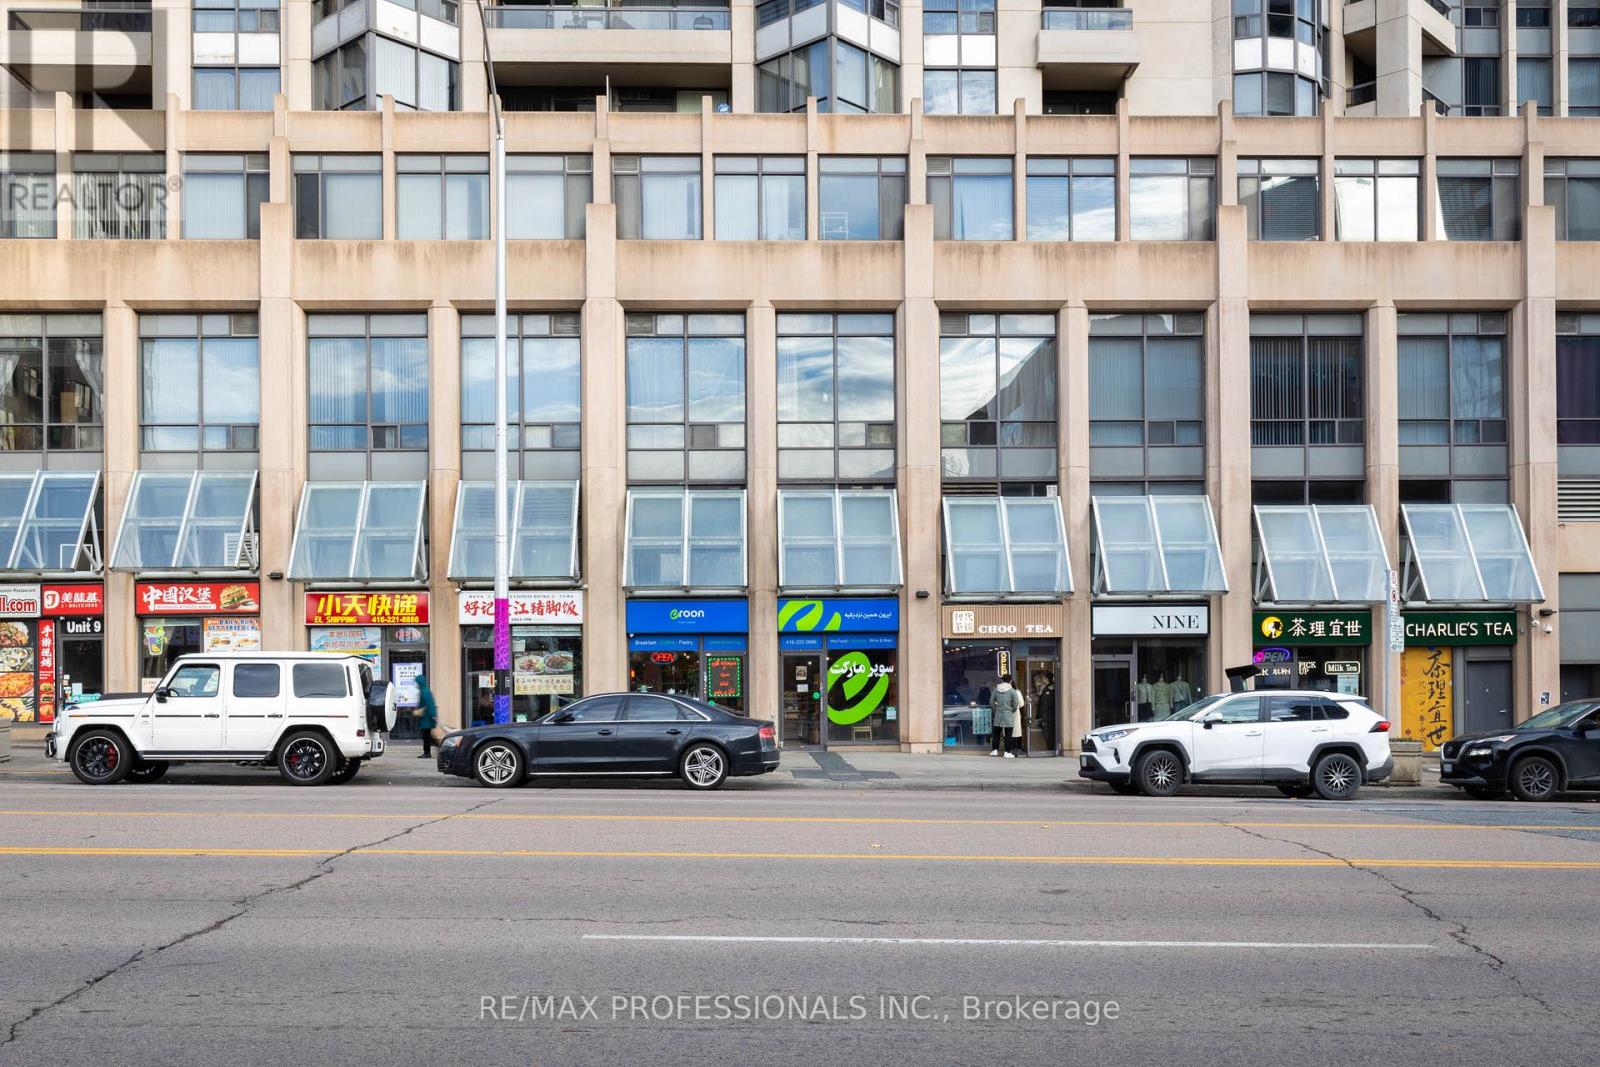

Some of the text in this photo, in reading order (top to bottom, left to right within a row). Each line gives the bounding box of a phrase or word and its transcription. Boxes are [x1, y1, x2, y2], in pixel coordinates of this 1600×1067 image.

[142, 585, 212, 612] 中国汉堡
[318, 594, 418, 616] 小天快递
[464, 600, 579, 617] 好记江猪脚饭
[670, 609, 704, 620] eroon
[66, 621, 101, 633] Unit 9
[979, 624, 1054, 634] CHOO TEA
[1153, 615, 1199, 629] NINE
[1288, 618, 1362, 637] 茶理宜世
[1405, 622, 1478, 637] CHARLIE'S
[1484, 622, 1513, 636] TEA
[1254, 651, 1286, 662] OPEN
[1298, 667, 1309, 675] UP
[1327, 664, 1358, 672] Milk Tea
[1423, 649, 1451, 748] 茶理宜世
